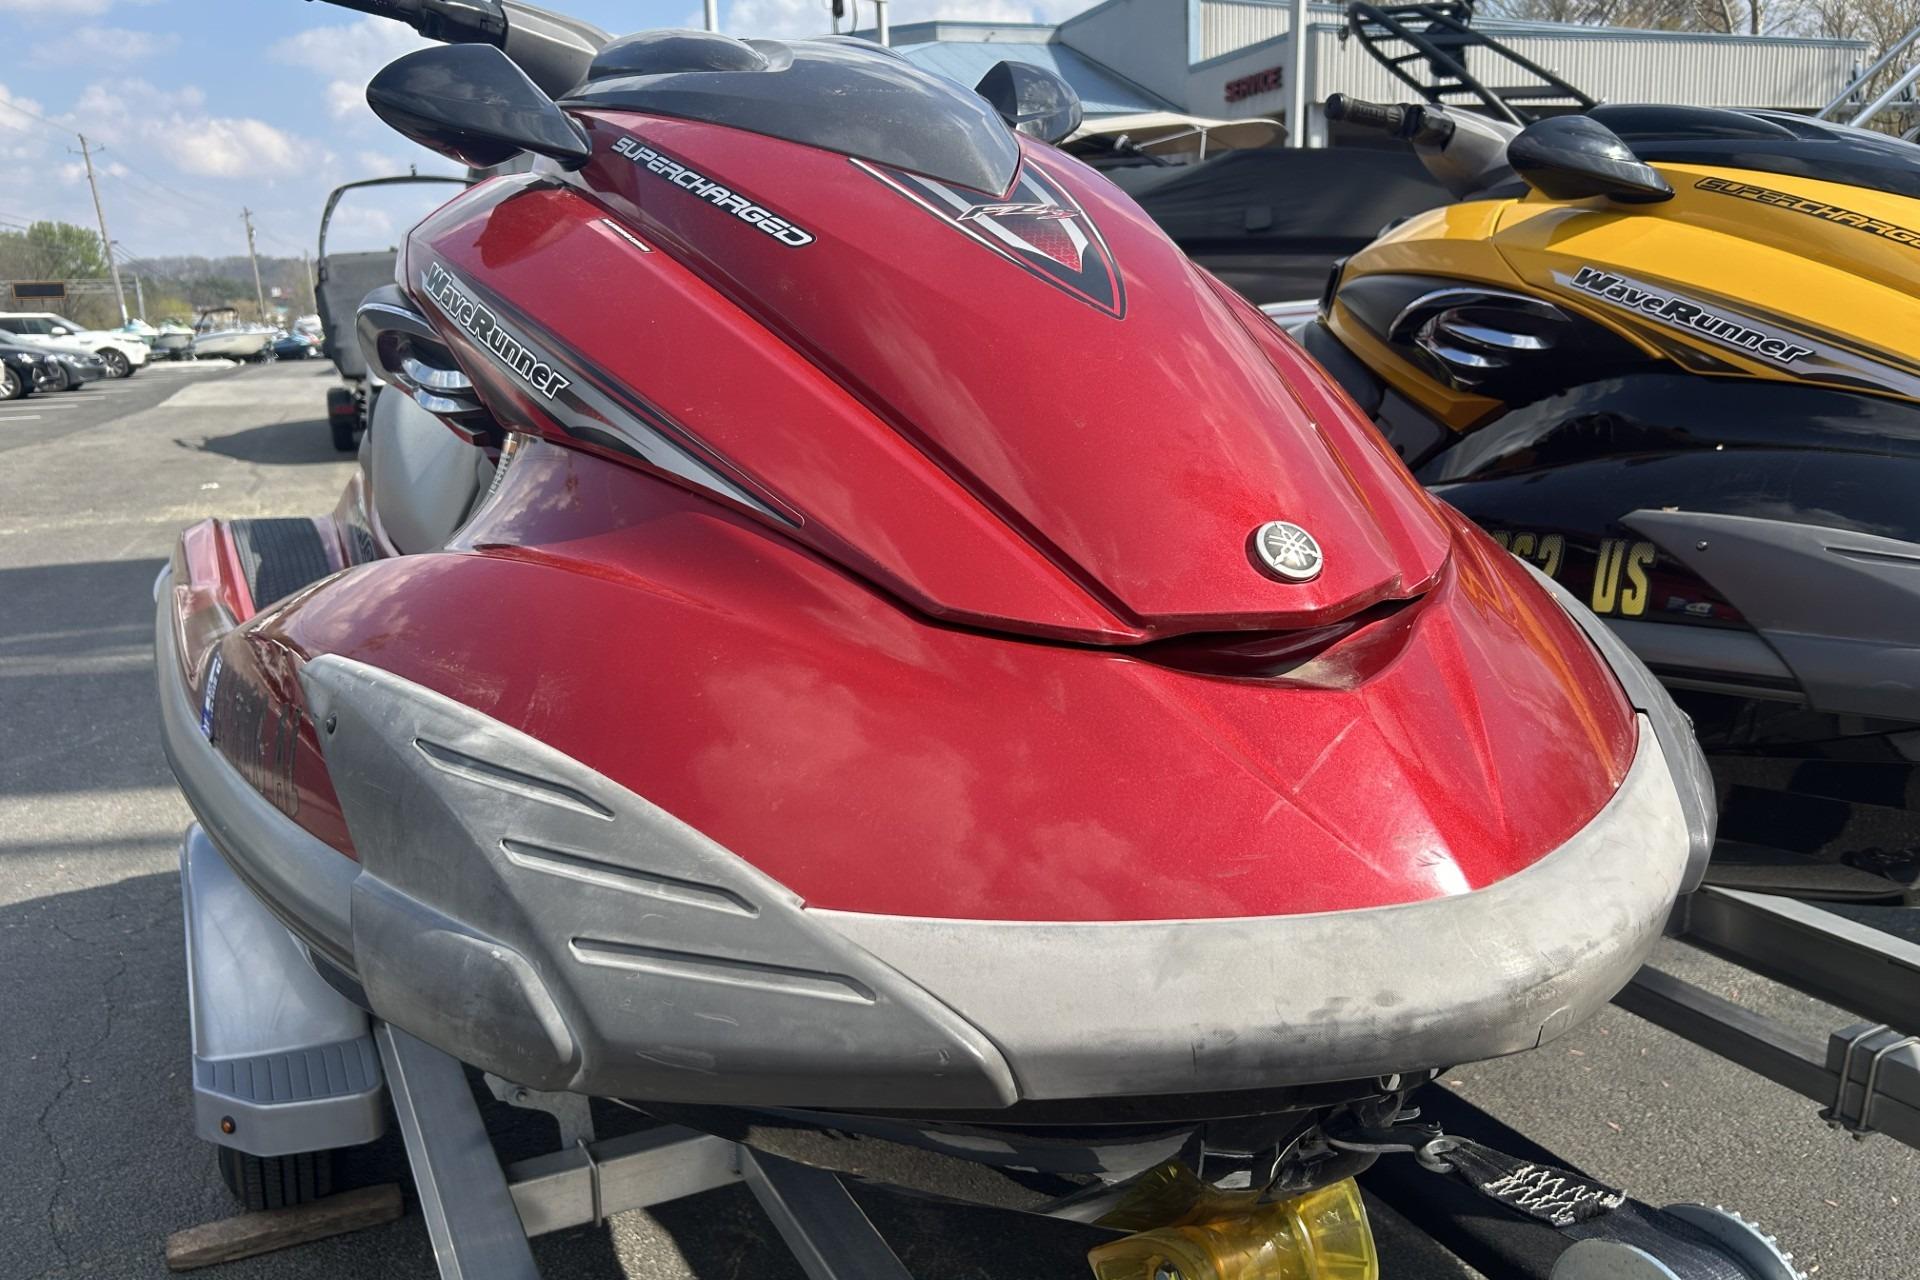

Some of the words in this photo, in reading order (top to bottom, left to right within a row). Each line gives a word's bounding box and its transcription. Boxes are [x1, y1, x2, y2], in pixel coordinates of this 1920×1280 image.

[611, 137, 813, 246] SUPERCHARGED
[425, 262, 572, 400] WaveRunner
[1570, 266, 1814, 363] WaveRunner
[1592, 541, 1655, 616] US
